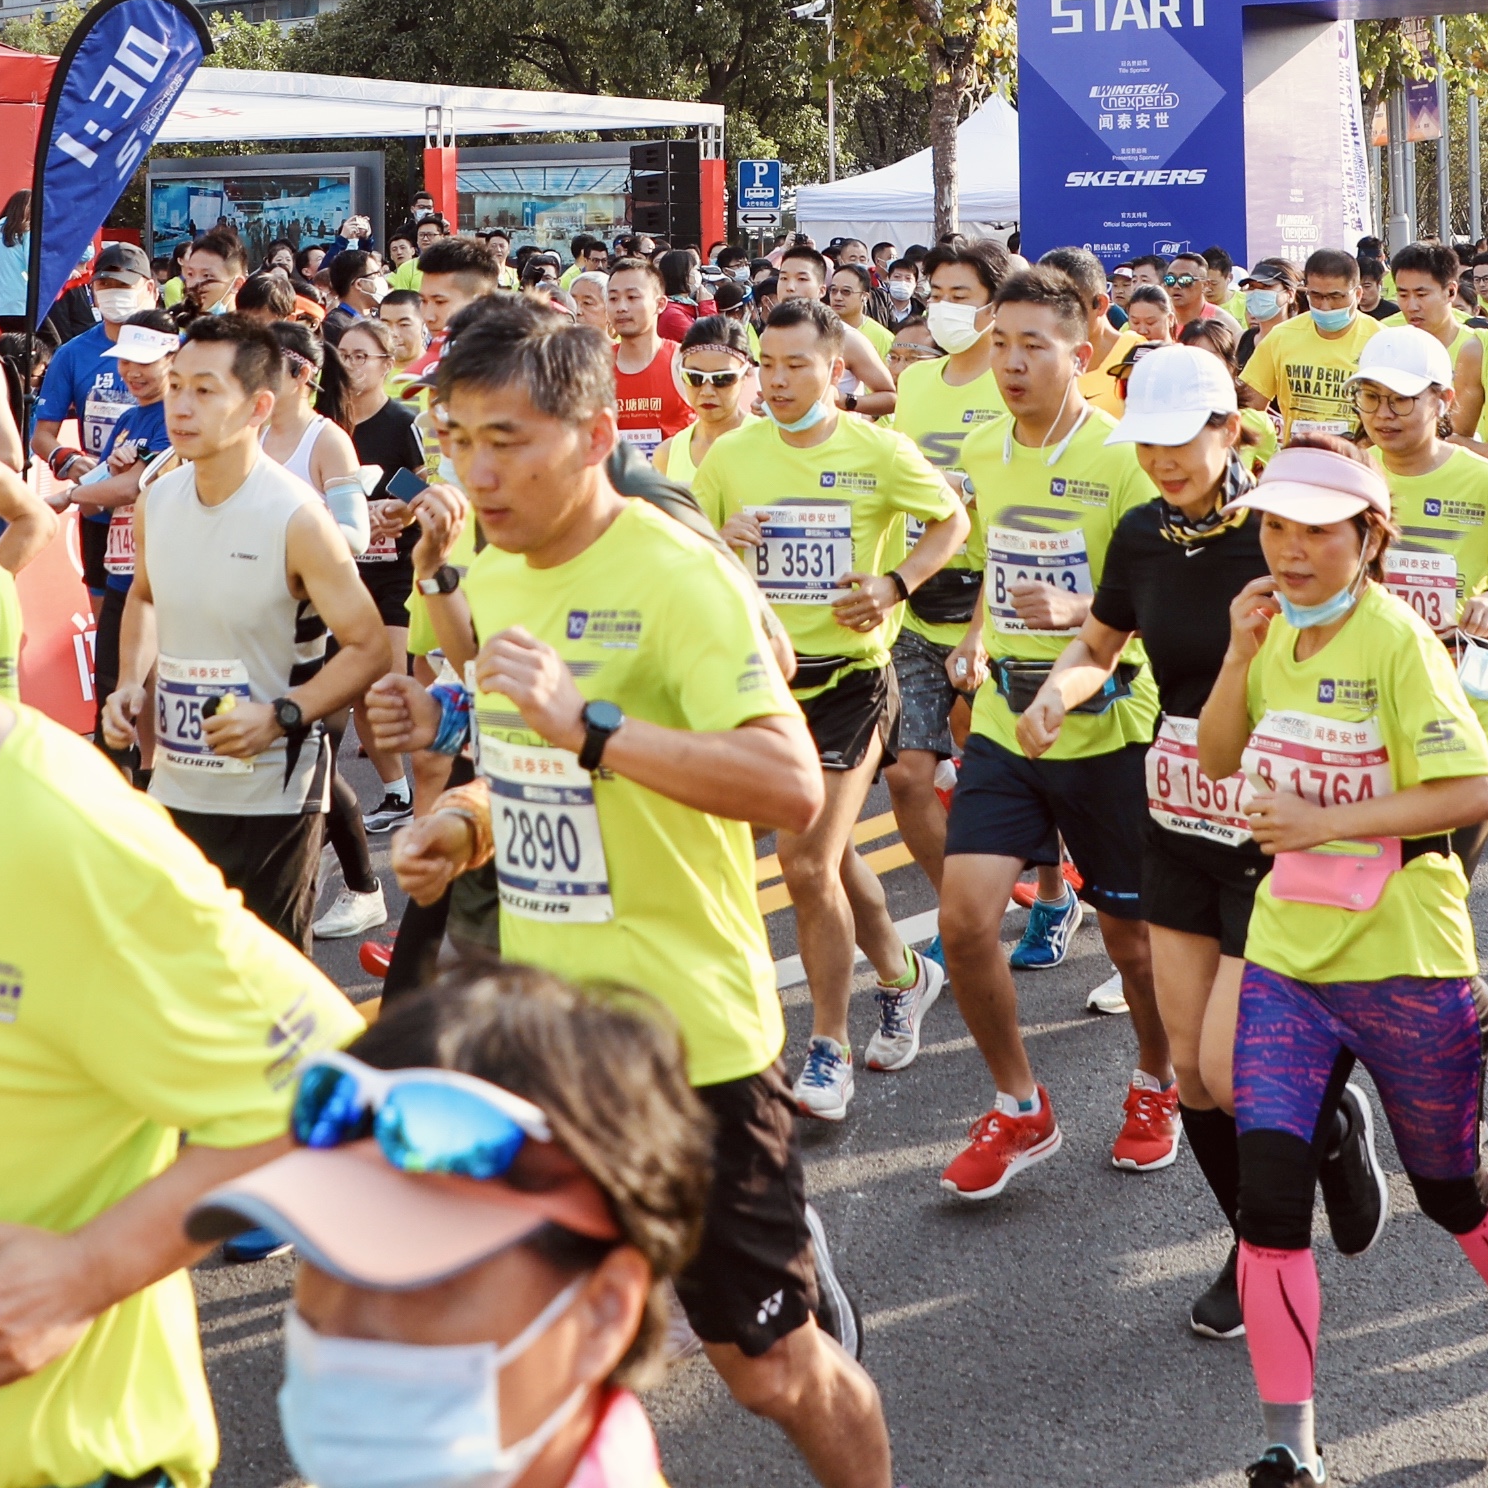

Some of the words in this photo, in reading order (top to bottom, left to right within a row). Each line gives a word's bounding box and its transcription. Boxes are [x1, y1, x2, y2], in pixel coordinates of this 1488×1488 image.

[1089, 84, 1168, 98] WINGTECH
[1109, 93, 1173, 111] nexperia
[1099, 113, 1169, 130] 闻泰安世
[753, 163, 768, 187] P
[1065, 169, 1207, 187] SKECHERS
[1286, 365, 1313, 378] BMW
[1288, 380, 1355, 397] MARATHO
[93, 426, 102, 448] B
[798, 513, 837, 523] 闻泰安世
[757, 544, 769, 576] B
[781, 543, 835, 577] 3531
[1399, 559, 1440, 570] 闻泰安世
[995, 566, 1006, 603] B
[765, 592, 828, 600] SKECHERS
[1315, 726, 1367, 744] 闻泰安世
[167, 753, 225, 768] SKECHERS
[513, 756, 565, 774] 闻泰安世
[1157, 757, 1170, 798] B
[1181, 763, 1246, 811] 1567
[1257, 757, 1276, 792] B
[1290, 767, 1375, 808] 1764
[503, 806, 580, 872] 2890
